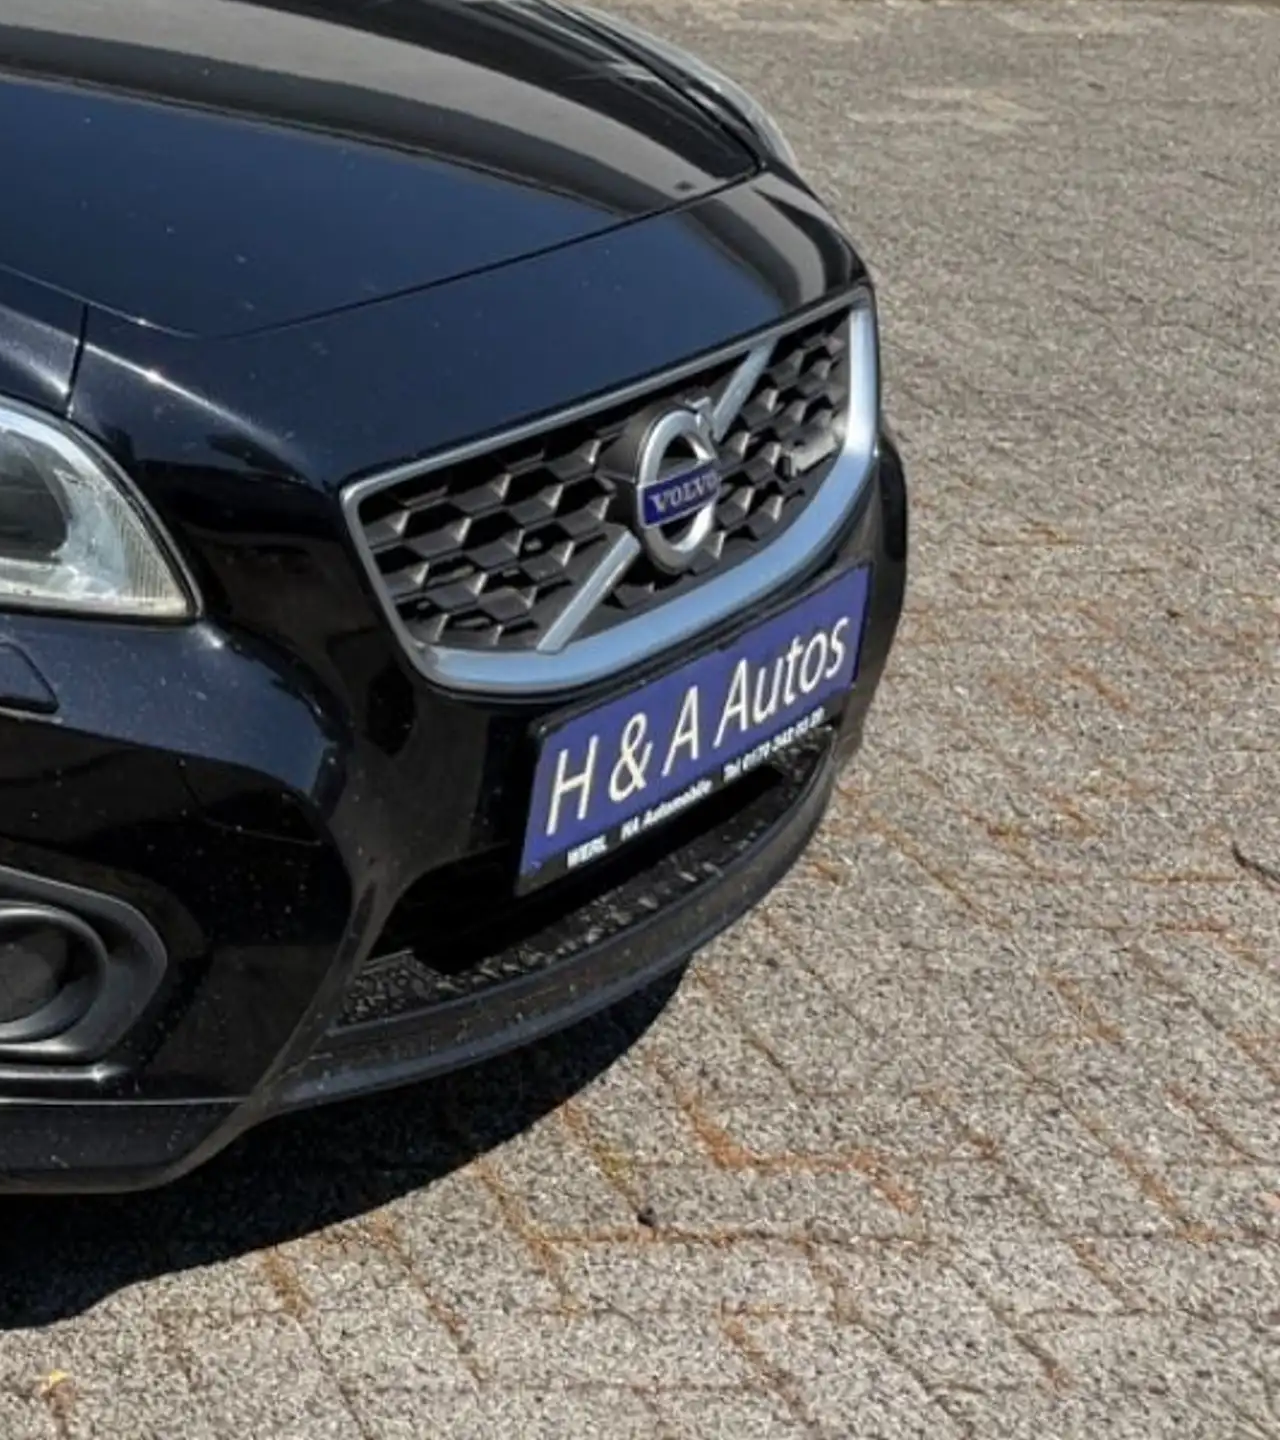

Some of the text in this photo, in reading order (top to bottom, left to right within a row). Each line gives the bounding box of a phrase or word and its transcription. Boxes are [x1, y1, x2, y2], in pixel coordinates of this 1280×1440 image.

[648, 469, 719, 513] VOLVO
[545, 616, 850, 837] H & A Autos
